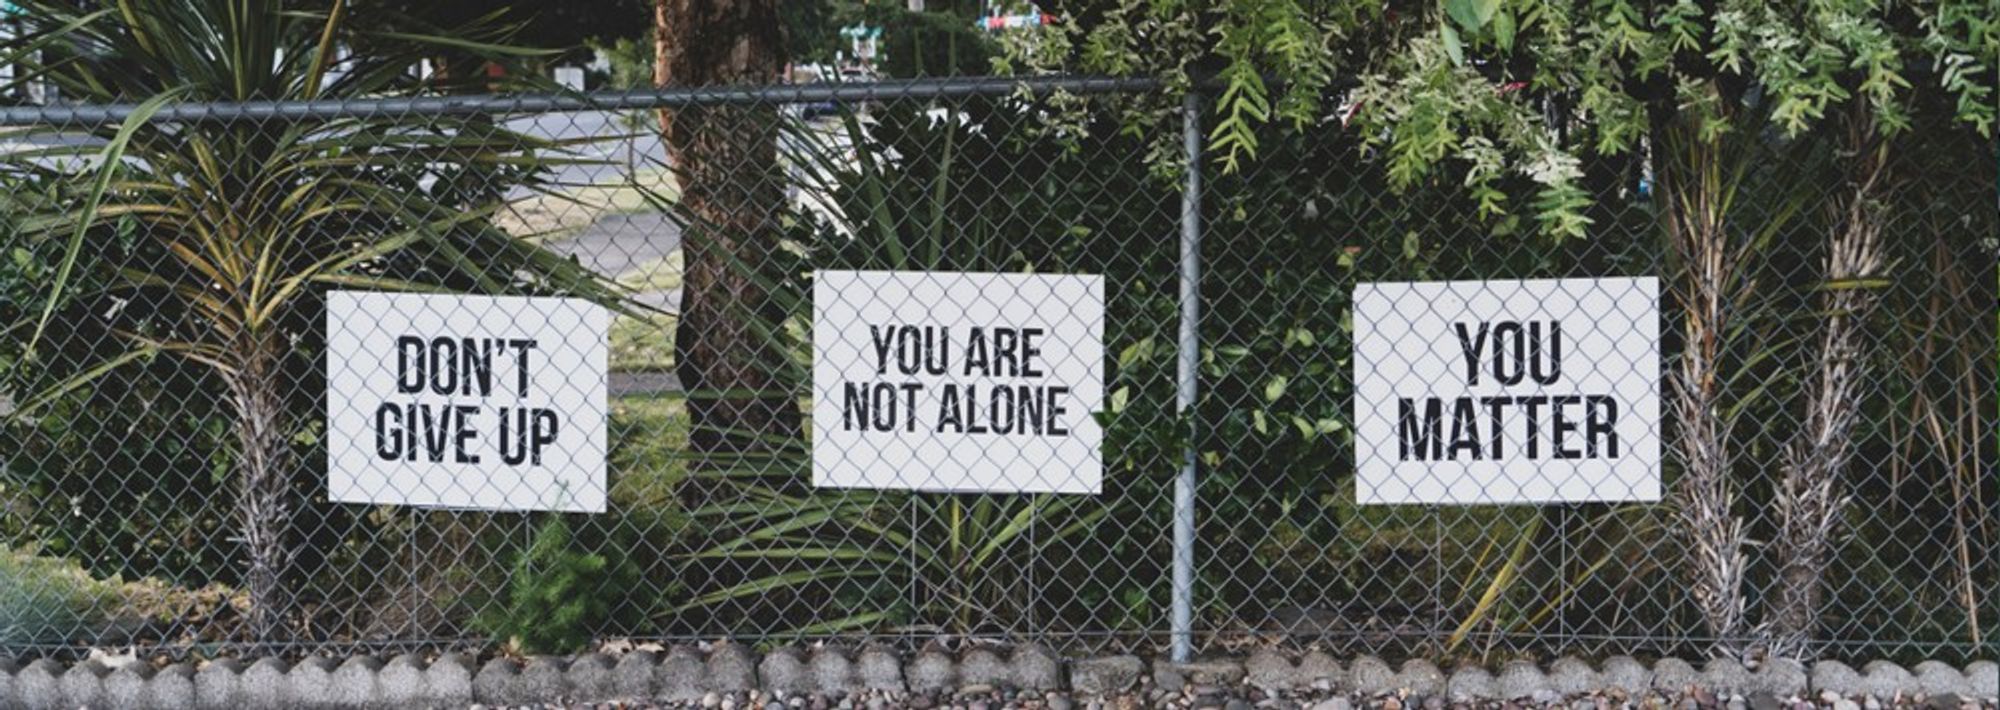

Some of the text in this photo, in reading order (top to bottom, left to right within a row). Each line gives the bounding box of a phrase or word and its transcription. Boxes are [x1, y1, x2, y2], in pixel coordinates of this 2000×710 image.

[397, 335, 537, 398] DON'T
[870, 324, 1044, 378] YOU ARE
[1454, 320, 1561, 387] YOU
[375, 402, 559, 466] GIVE UP
[843, 381, 1069, 436] NOT ALONE
[1399, 394, 1619, 461] MATTER
